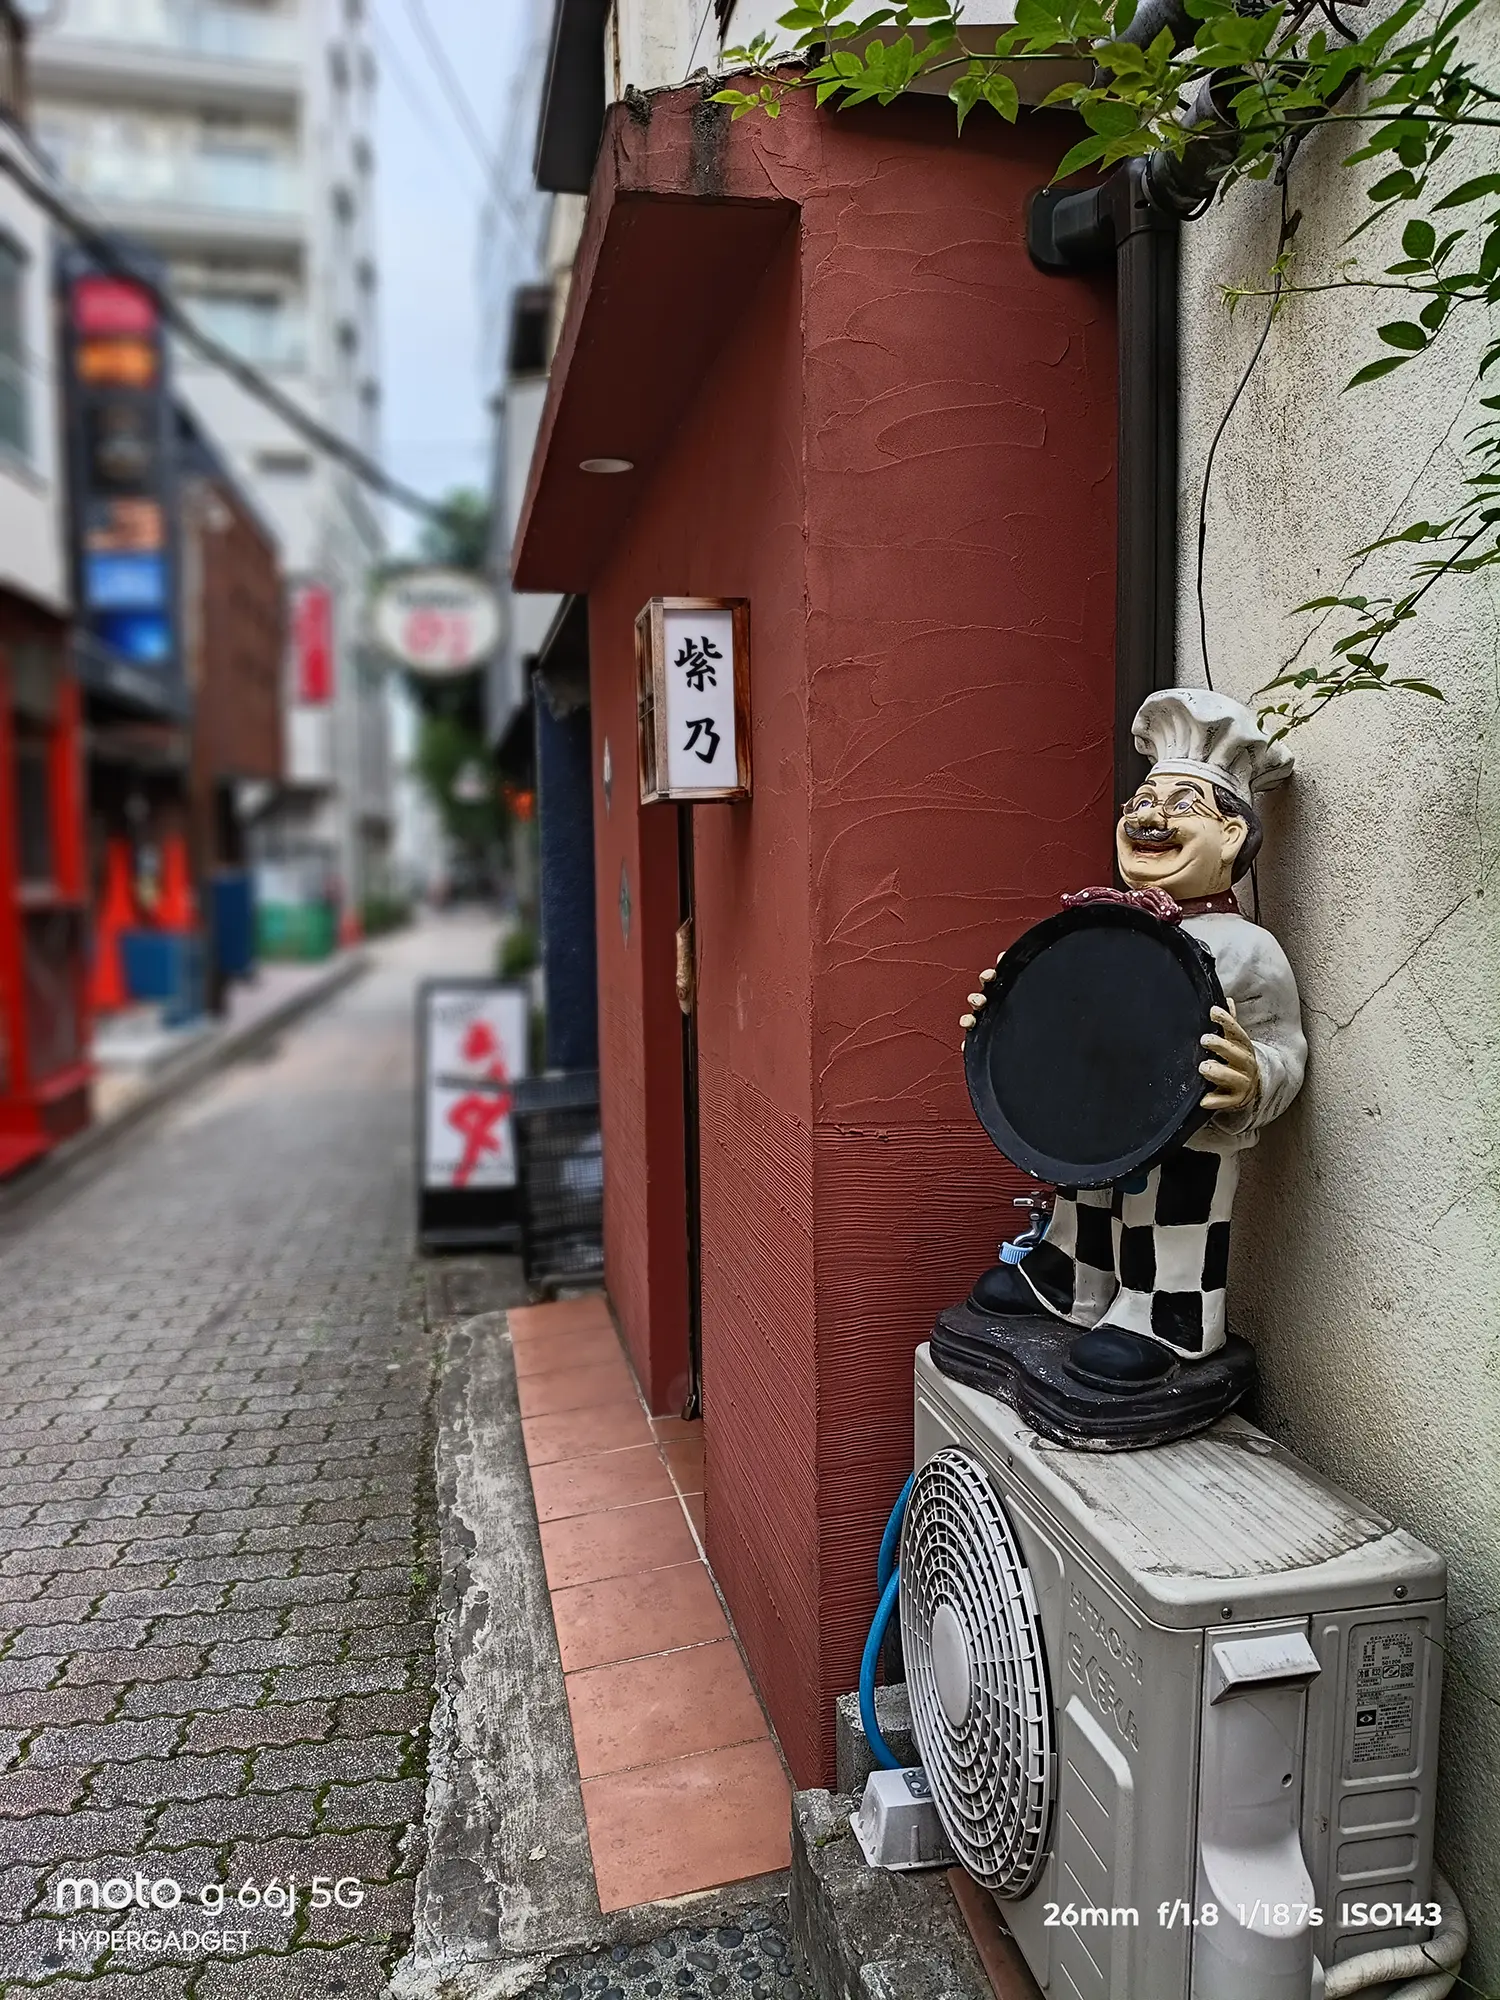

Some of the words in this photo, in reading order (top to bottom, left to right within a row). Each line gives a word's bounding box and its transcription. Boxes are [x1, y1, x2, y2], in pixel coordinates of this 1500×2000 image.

[673, 635, 724, 764] 紫乃
[1067, 1631, 1140, 1753] 白くまくん
[1069, 1581, 1143, 1686] HITACHI
